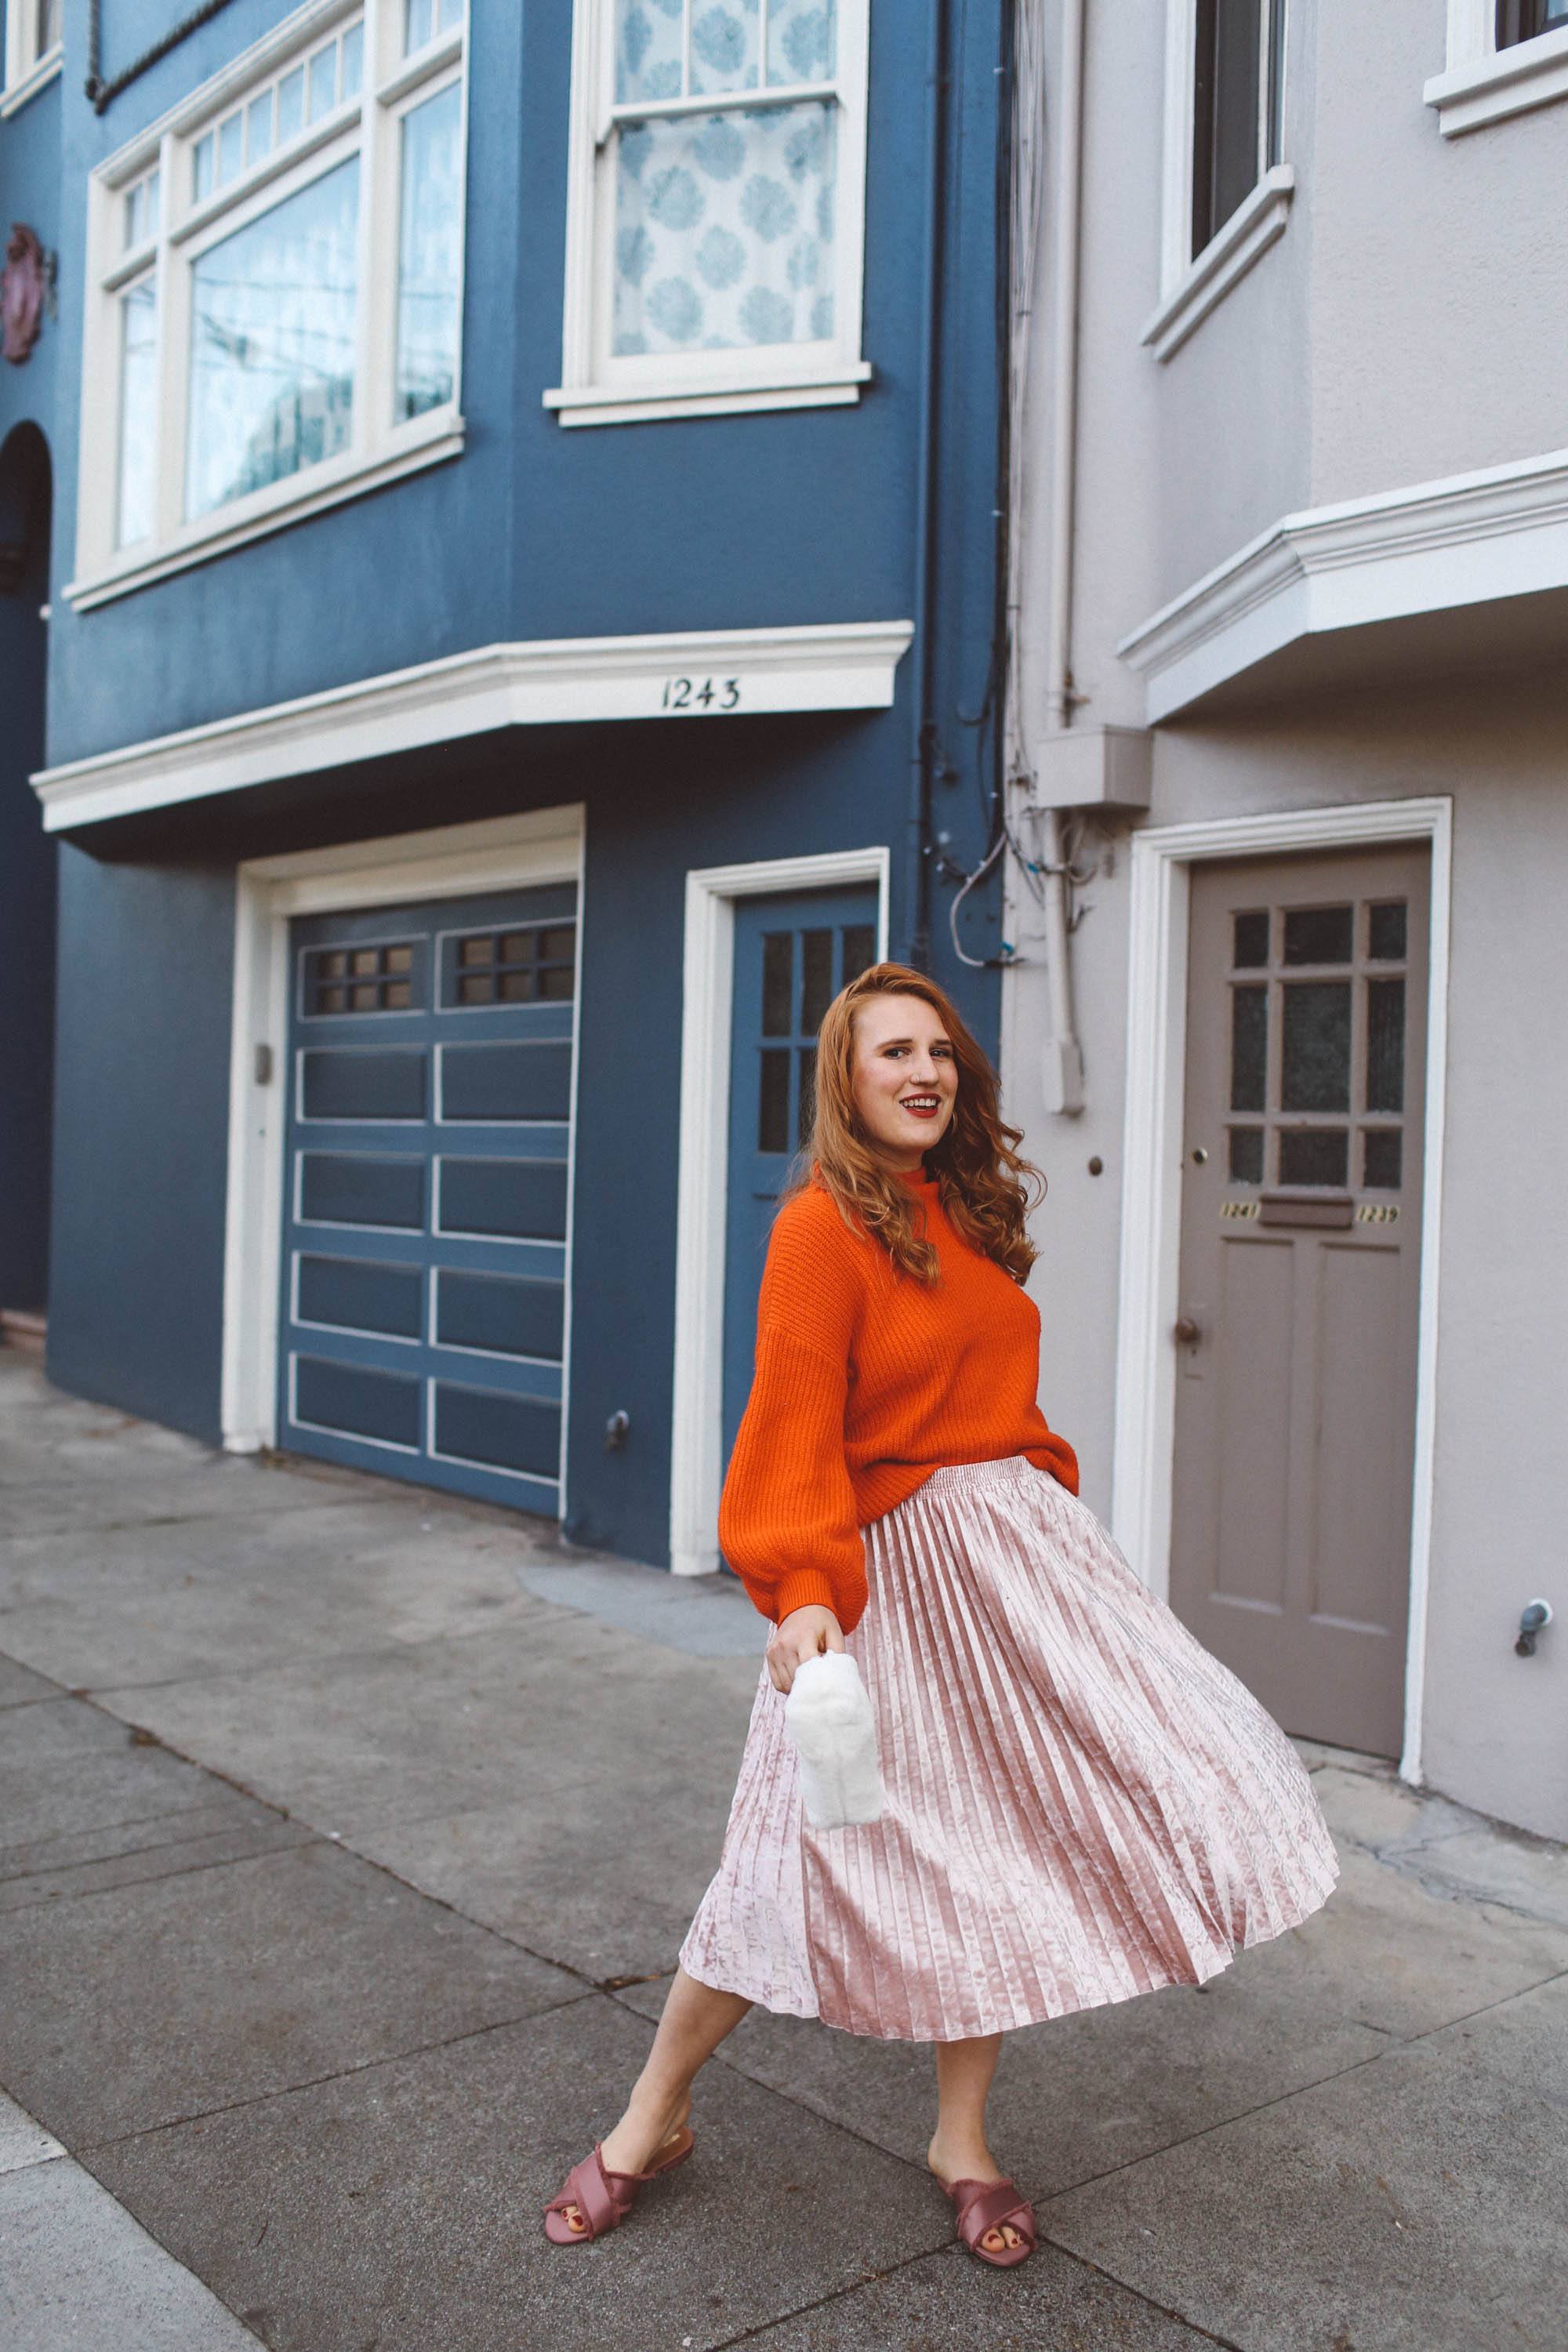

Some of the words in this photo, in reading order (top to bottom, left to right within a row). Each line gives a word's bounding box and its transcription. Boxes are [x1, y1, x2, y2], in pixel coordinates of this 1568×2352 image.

[662, 677, 741, 710] 1243
[1222, 1203, 1258, 1218] 1241
[1359, 1204, 1399, 1222] 1239
